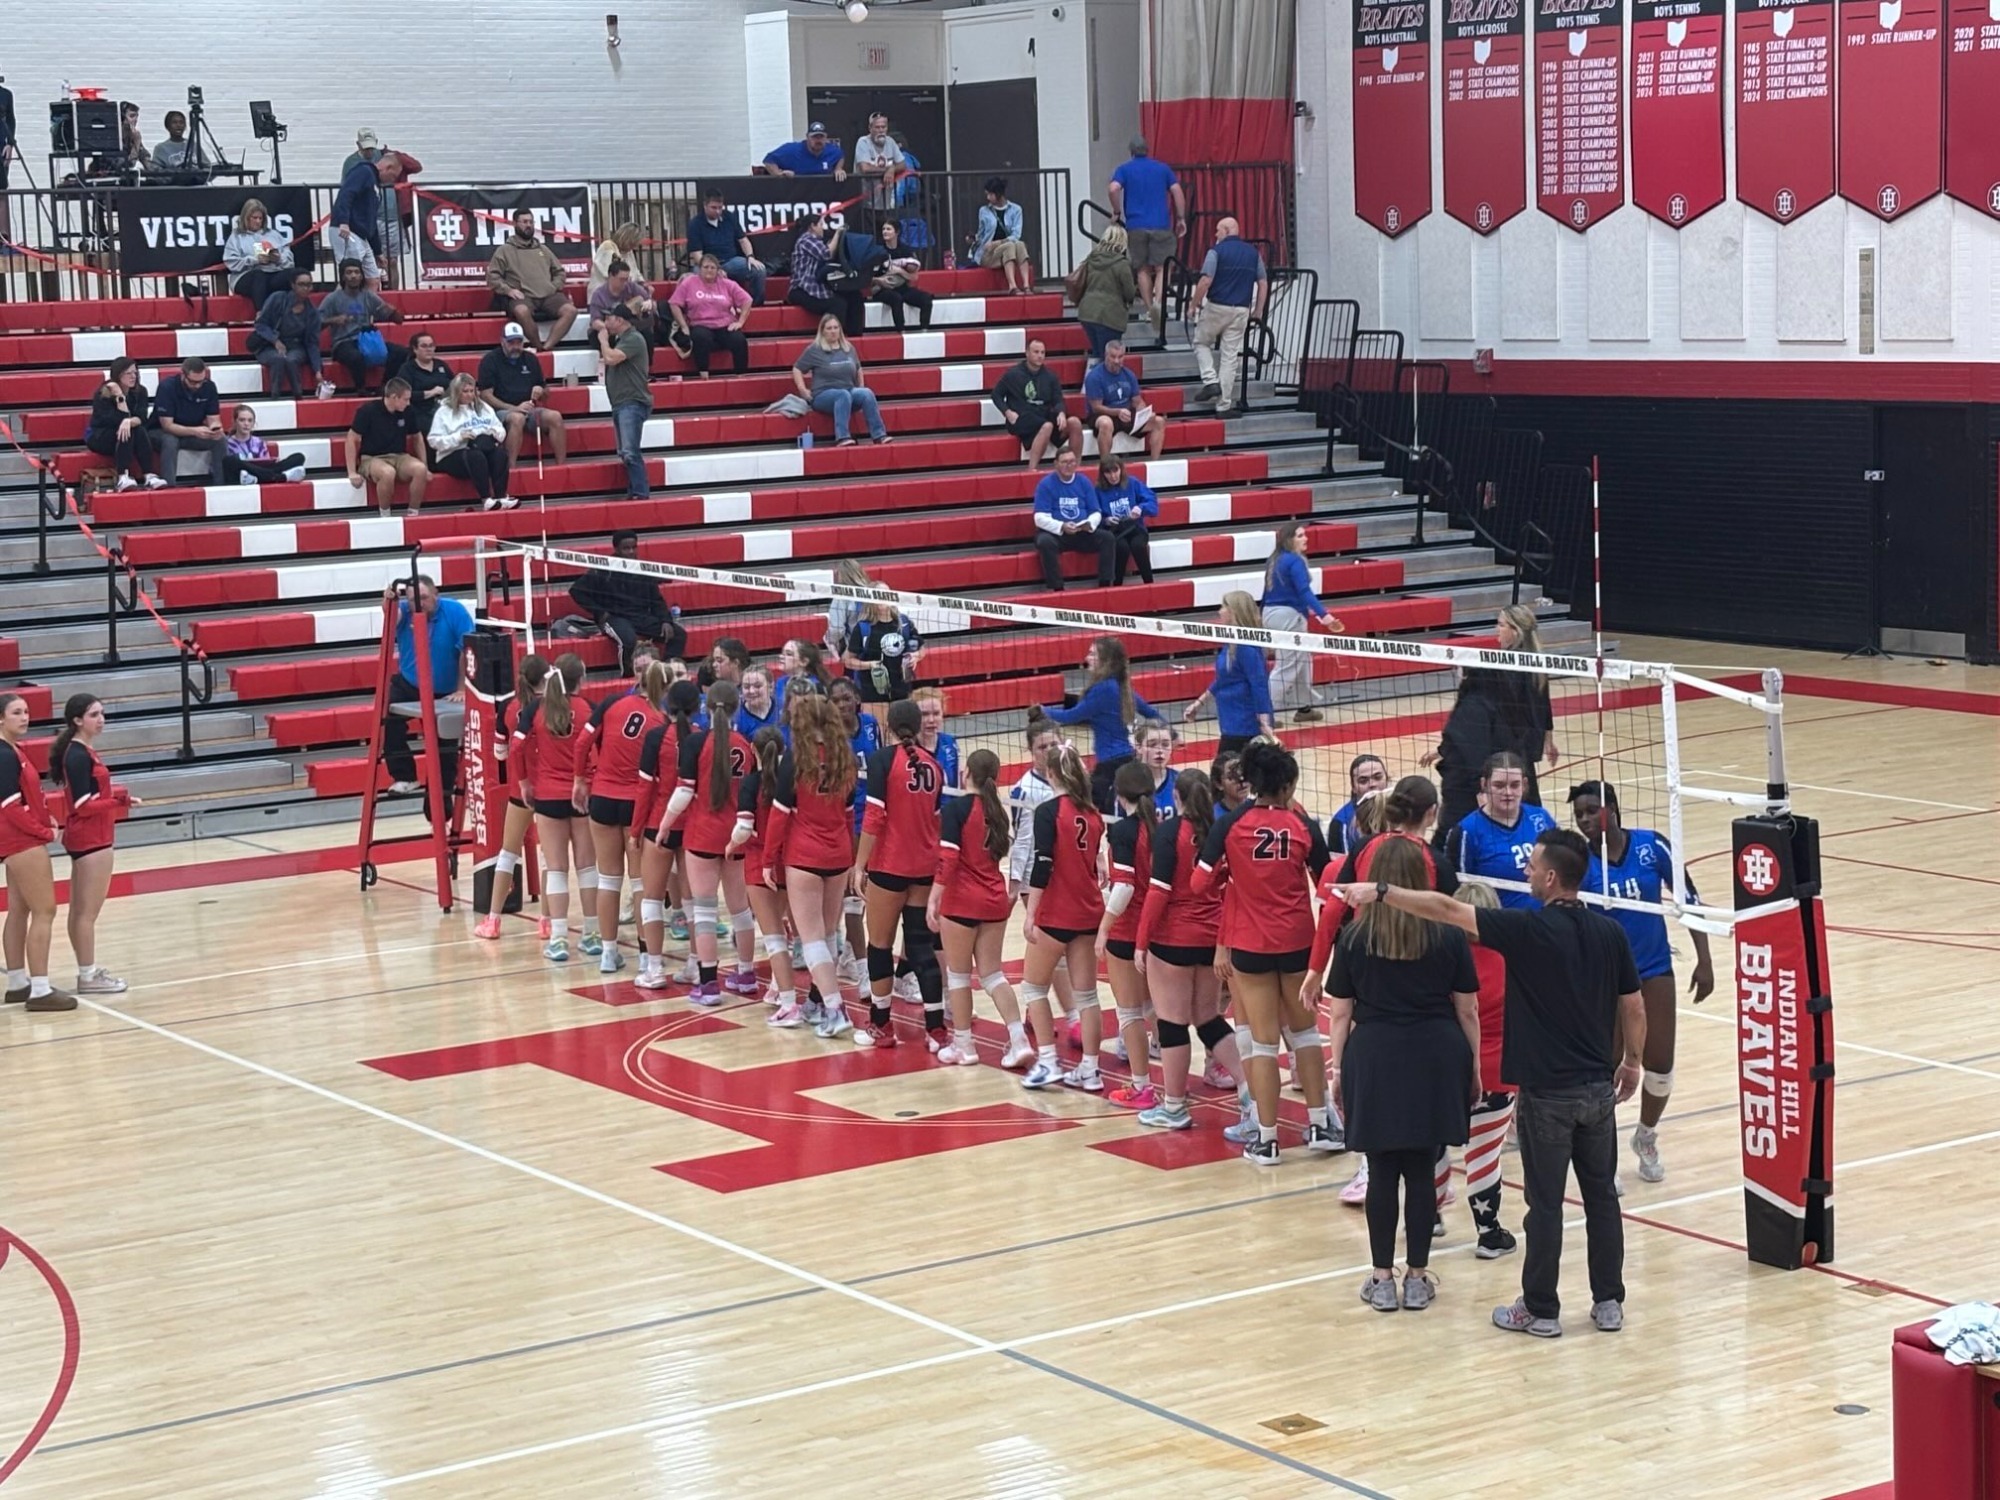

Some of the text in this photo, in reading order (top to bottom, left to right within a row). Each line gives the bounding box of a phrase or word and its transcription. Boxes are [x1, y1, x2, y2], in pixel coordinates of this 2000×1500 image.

[1448, 0, 1518, 23] BRAVES
[1654, 3, 1700, 17] BOYS TENNIS
[1358, 4, 1425, 32] BRAVES
[1556, 13, 1600, 28] BOYS TENNIS
[1458, 22, 1507, 37] BOYS LACROSSE
[1871, 32, 1892, 44] STATE
[1893, 29, 1937, 42] RUNNER-UP
[1954, 27, 1974, 39] 2020
[1364, 31, 1417, 46] BOYS BASKETBALL
[1766, 41, 1785, 52] STATE
[1786, 38, 1805, 50] FINAL
[1807, 36, 1827, 48] FOUR
[1954, 40, 1973, 52] 2021
[1638, 47, 1717, 63] 2021 STATE RUNNER-UP
[1766, 52, 1785, 64] STATE
[1786, 49, 1827, 62] RUNNER-UP
[1468, 67, 1484, 78] STATE
[1485, 64, 1519, 76] CHAMPIONS
[1562, 60, 1580, 71] STATE
[1581, 56, 1617, 69] RUNNER-UP
[1637, 59, 1716, 75] 2022 STATE CHAMPIONS
[1766, 65, 1785, 76] STATE
[1786, 62, 1827, 74] RUNNER-UP
[1377, 74, 1391, 85] STATE
[1393, 71, 1425, 83] RUNNER-UP
[1468, 78, 1484, 89] STATE
[1485, 76, 1519, 88] CHAMPIONS
[1562, 71, 1580, 82] STATE
[1581, 68, 1617, 80] CHAMPIONS
[1636, 70, 1713, 86] 2023 STATE RUNNER-UP
[1766, 77, 1785, 88] STATE
[1786, 75, 1805, 86] FINAL
[1807, 74, 1827, 84] FOUR
[1468, 89, 1484, 100] STATE
[1485, 87, 1519, 98] CHAMPIONS
[1562, 83, 1580, 93] STATE
[1581, 80, 1617, 92] CHAMPIONS
[1636, 82, 1715, 98] 2024 STATE CHAMPIONS
[1743, 86, 1828, 102] 2024 STATE CHAMPIONS
[1562, 94, 1580, 105] STATE
[1581, 92, 1617, 103] RUNNER-UP
[1562, 106, 1580, 116] STATE
[1581, 103, 1617, 114] CHAMPIONS
[1562, 117, 1580, 127] STATE
[1581, 115, 1617, 126] RUNNER-UP
[1562, 129, 1580, 139] STATE
[1581, 127, 1617, 138] CHAMPIONS
[1562, 140, 1580, 150] STATE
[1581, 138, 1617, 149] CHAMPIONS
[1562, 151, 1580, 161] STATE
[1581, 150, 1617, 160] RUNNER-UP
[1562, 163, 1580, 173] STATE
[1581, 161, 1617, 172] CHAMPIONS
[1562, 174, 1580, 184] STATE
[1581, 172, 1617, 183] CHAMPIONS
[1562, 184, 1580, 194] STATE
[1581, 183, 1617, 194] RUNNER-UP
[722, 202, 845, 232] ISITORS
[140, 214, 293, 248] VISITS
[427, 267, 462, 277] INDIAN
[464, 266, 485, 276] HILL
[1055, 610, 1136, 629] INDIAN HILL BRAVES
[1183, 623, 1272, 643] INDIAN HILL BRAVES
[1324, 637, 1421, 656] INDIAN HILL BRAVES
[1480, 651, 1588, 671] INDIAN HILL BRAVES
[622, 711, 647, 739] 8
[470, 709, 487, 846] BRAVES
[905, 760, 936, 793] 30
[1074, 816, 1088, 850] 2
[1253, 827, 1291, 861] 21
[1609, 877, 1641, 900] 14
[1740, 942, 1777, 1160] BRAVES
[1778, 969, 1799, 1139] INDIAN HILL
